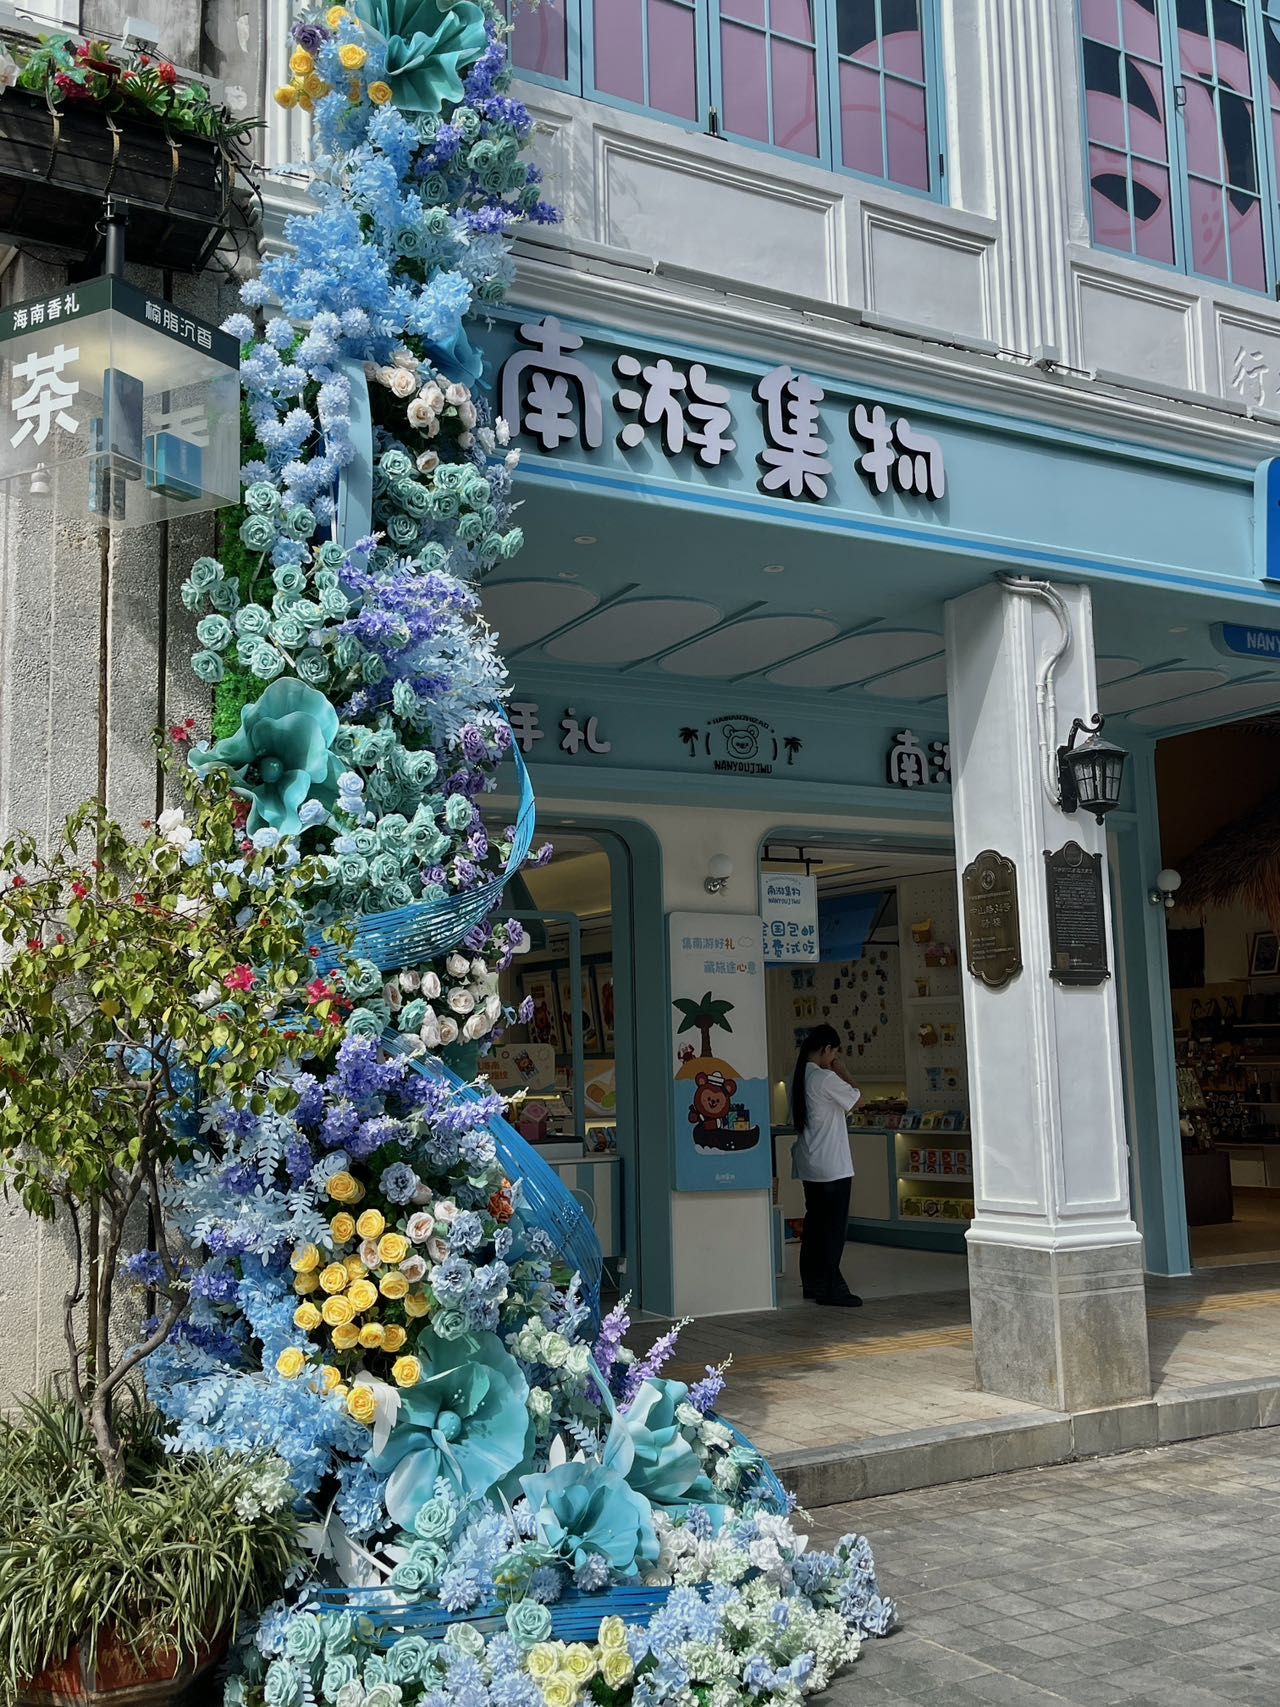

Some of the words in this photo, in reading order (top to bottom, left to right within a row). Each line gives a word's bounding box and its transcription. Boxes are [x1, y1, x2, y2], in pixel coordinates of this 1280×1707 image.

[13, 292, 80, 331] 海南香礼
[9, 343, 80, 449] 茶
[1232, 345, 1280, 407] 行
[501, 315, 945, 500] 南游集物
[714, 760, 773, 774] NANYOUJIWU
